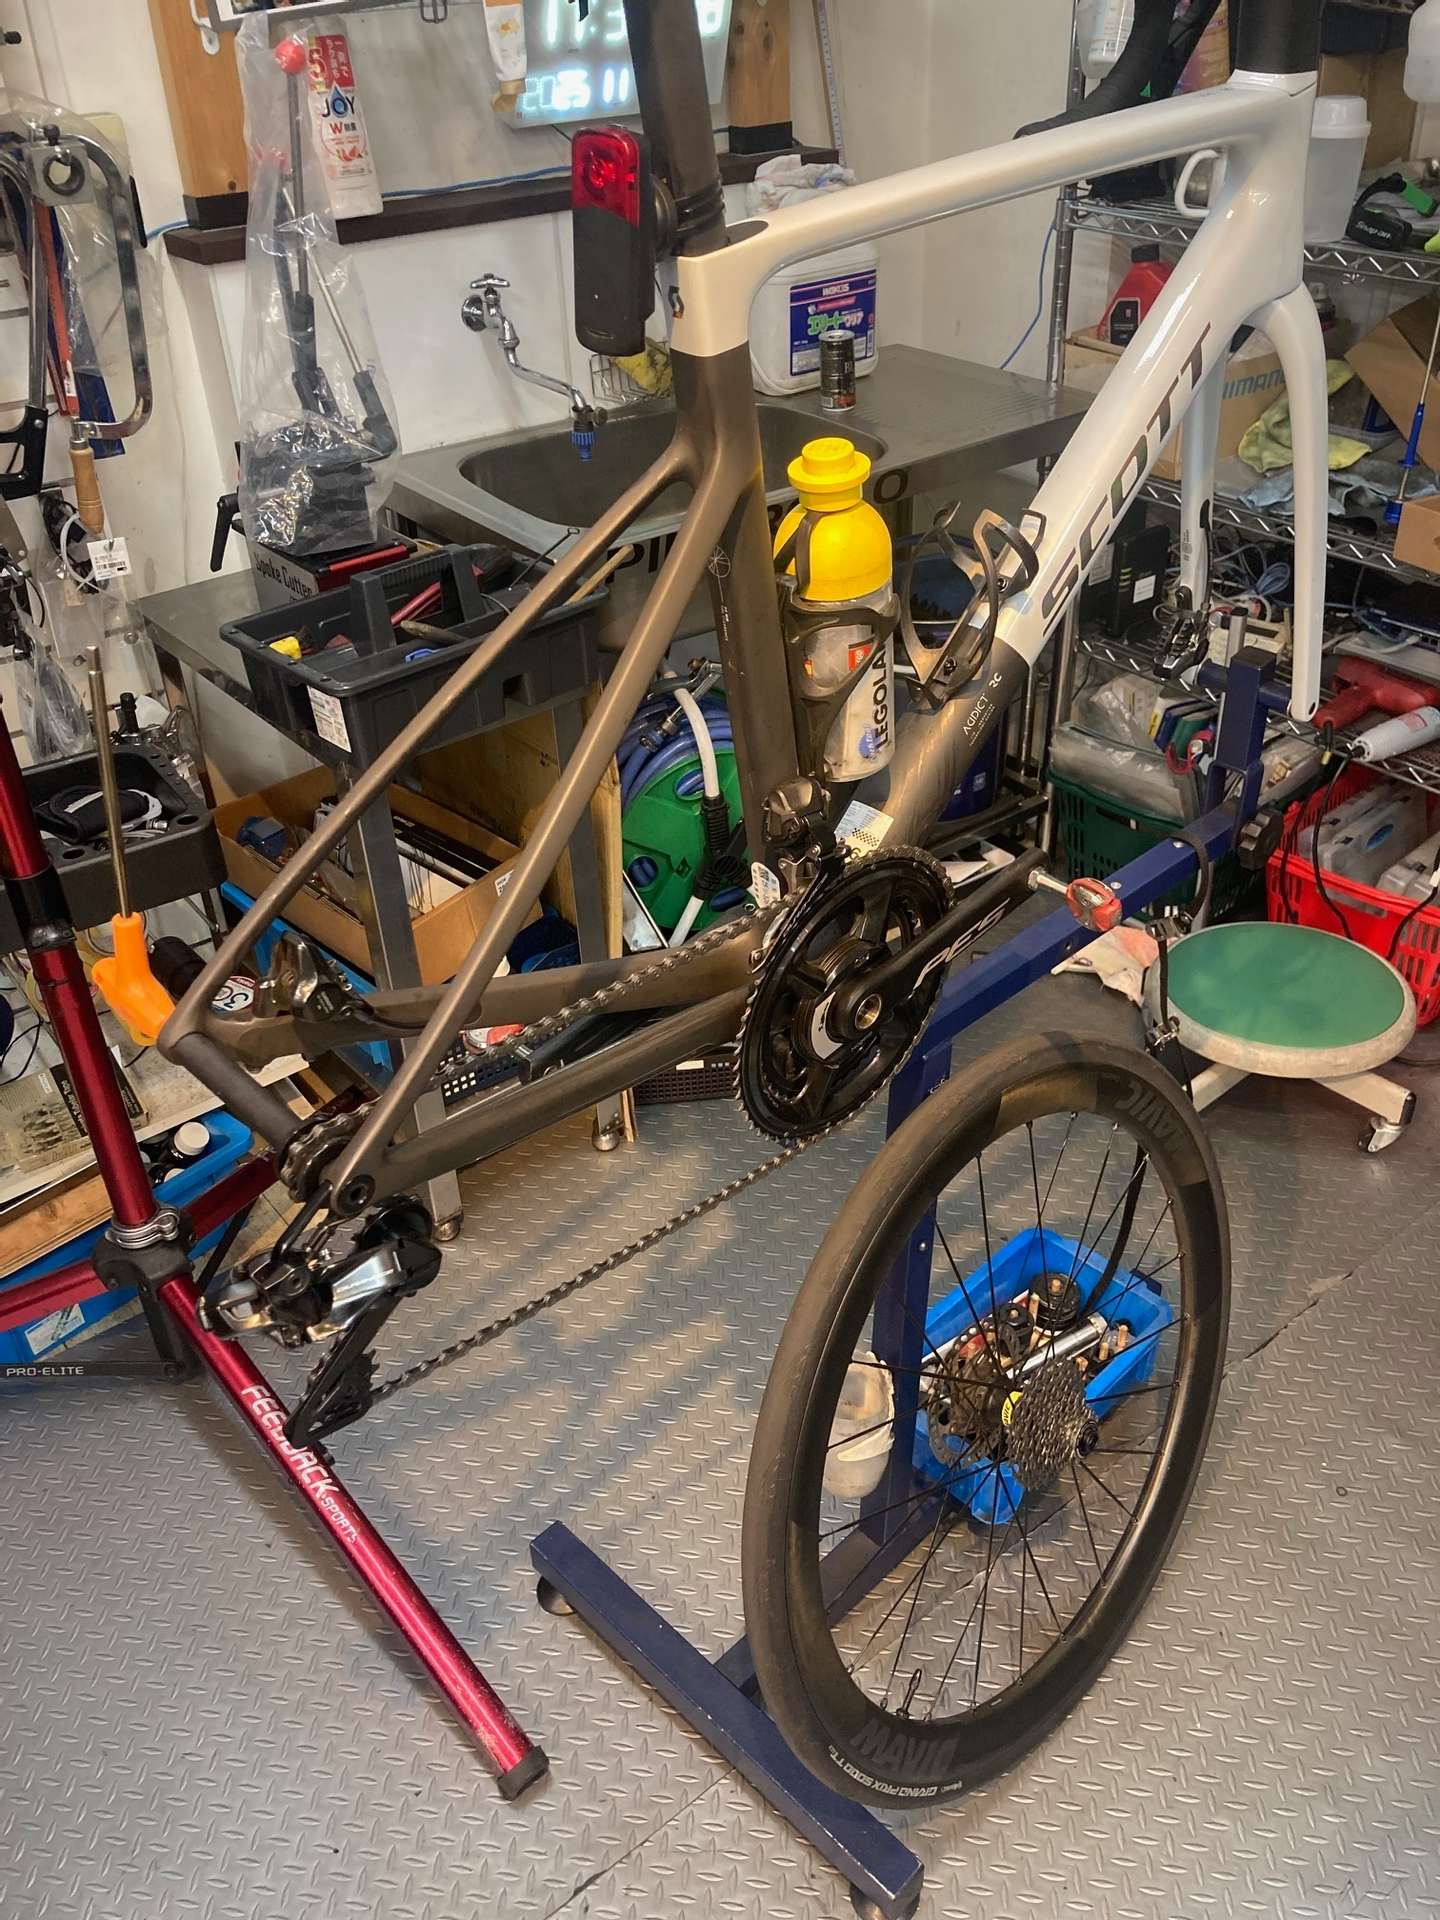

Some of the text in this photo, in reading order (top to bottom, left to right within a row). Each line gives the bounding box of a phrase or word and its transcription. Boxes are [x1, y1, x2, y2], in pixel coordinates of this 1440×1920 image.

[322, 95, 356, 118] JOY
[1042, 321, 1211, 638] SCOTT
[254, 551, 313, 600] Spoke Cutter
[872, 646, 889, 751] LEGOLA
[963, 692, 989, 736] ADDICT
[6, 1366, 85, 1377] PRO-ELITE
[321, 1496, 359, 1543] SPORTS
[842, 1762, 875, 1787] 5000
[871, 1779, 900, 1796] PRIX
[898, 1786, 938, 1797] GRAND
